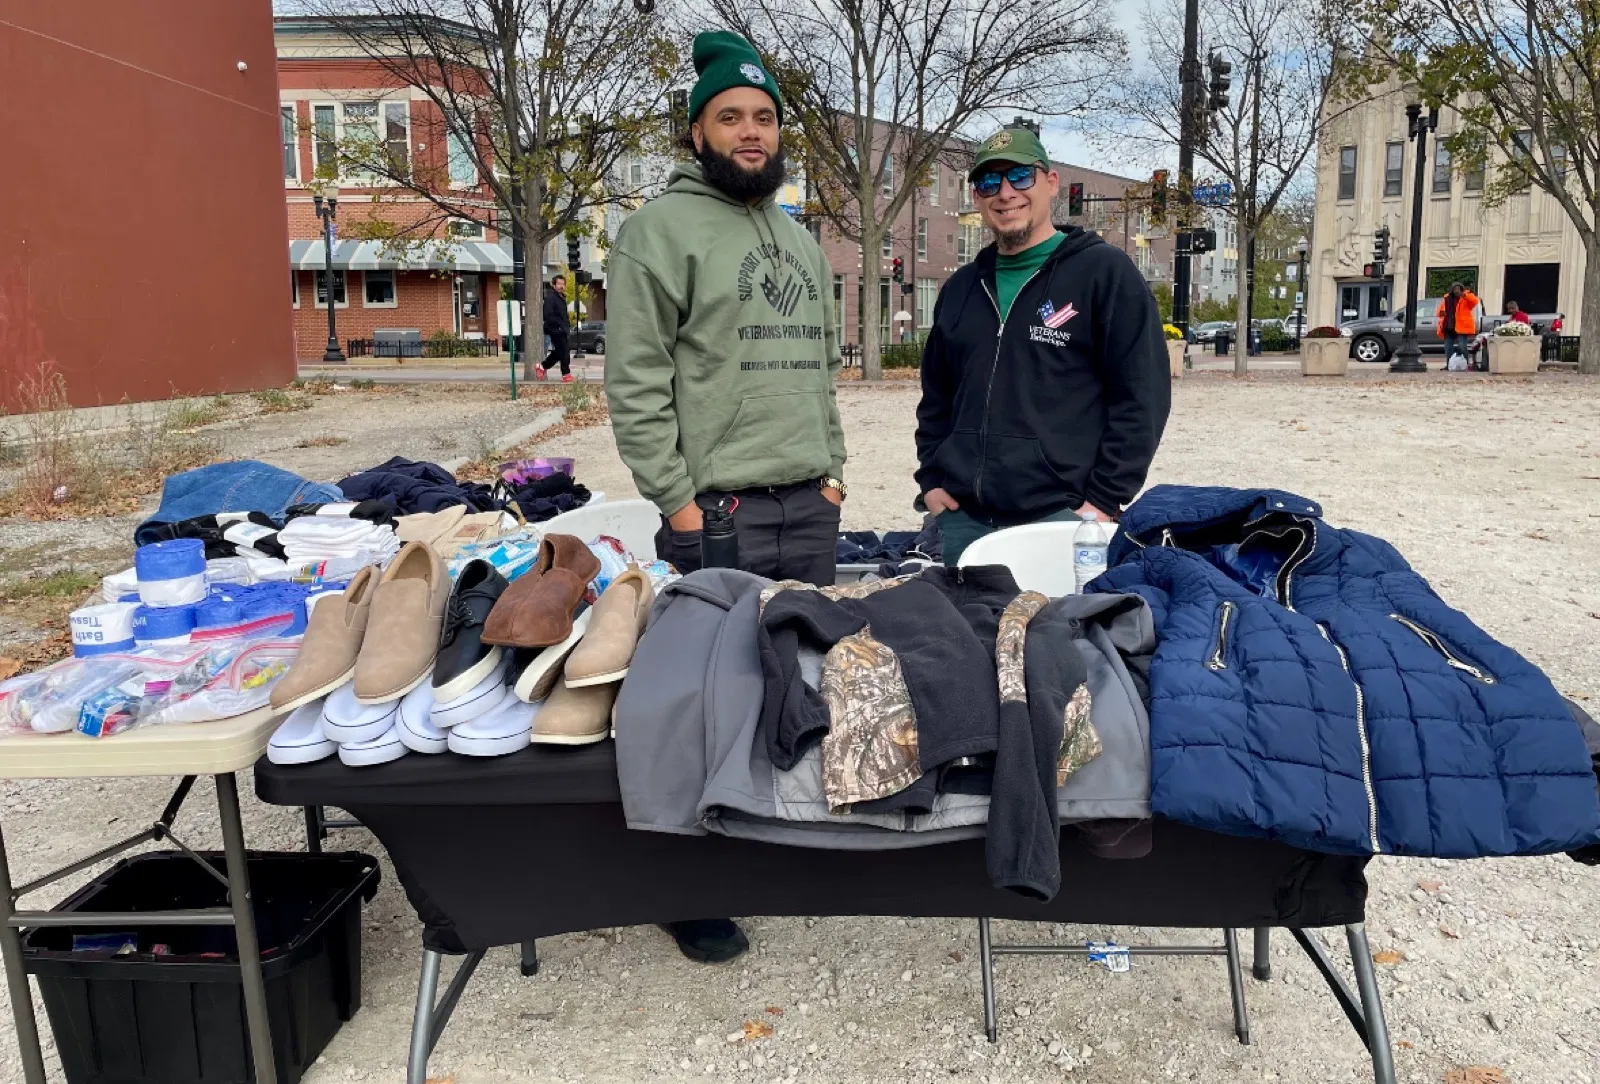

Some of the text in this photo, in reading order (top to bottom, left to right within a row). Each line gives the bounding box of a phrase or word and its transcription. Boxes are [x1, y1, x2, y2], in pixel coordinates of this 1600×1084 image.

[738, 251, 761, 302] SUPPORT
[785, 249, 818, 301] VETERANS
[738, 325, 781, 341] VETERANS
[70, 616, 103, 628] Tissu
[75, 631, 104, 642] Bath
